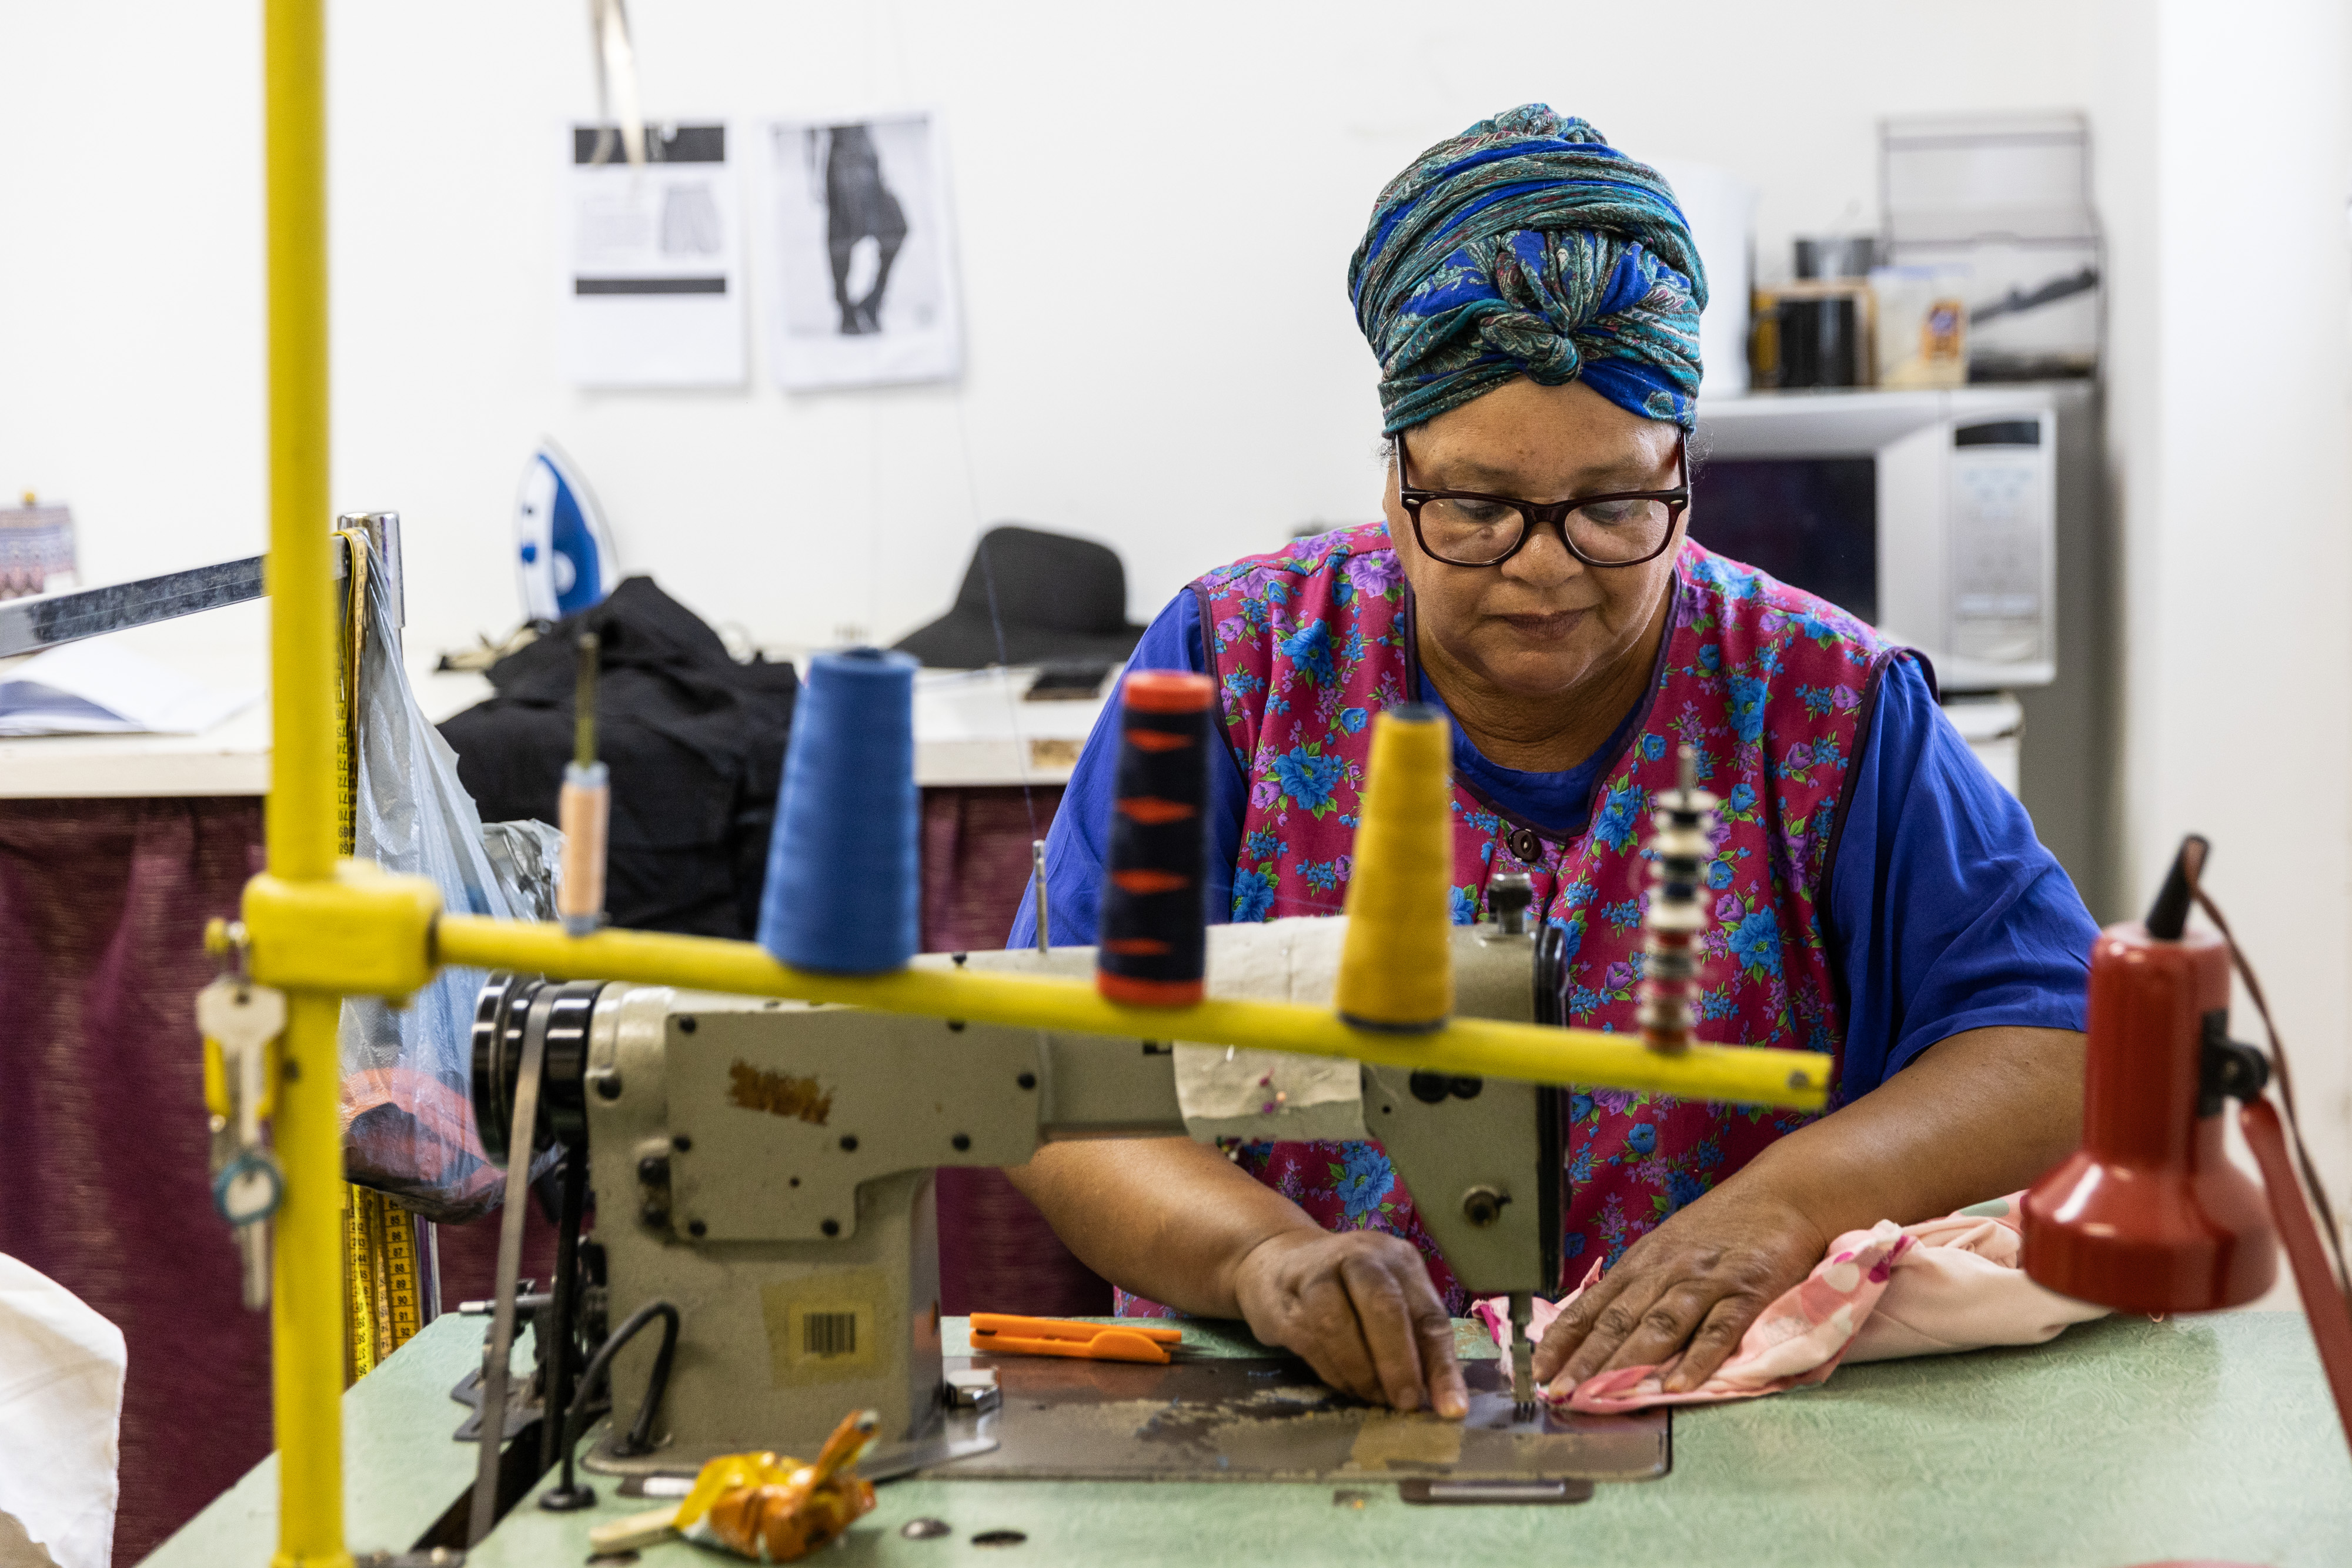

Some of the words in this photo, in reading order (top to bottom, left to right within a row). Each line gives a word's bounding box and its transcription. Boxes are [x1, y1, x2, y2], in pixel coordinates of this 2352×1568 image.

[337, 759, 348, 771] 73
[338, 776, 348, 788] 72
[339, 794, 348, 804] 71
[338, 809, 348, 821] 70
[338, 827, 349, 838] 69
[339, 843, 349, 854] 68
[390, 1215, 400, 1225] 85
[393, 1247, 403, 1256] 87
[395, 1263, 405, 1272] 88
[396, 1279, 406, 1289] 89
[397, 1295, 407, 1304] 90
[399, 1312, 407, 1320] 91
[400, 1328, 410, 1336] 92
